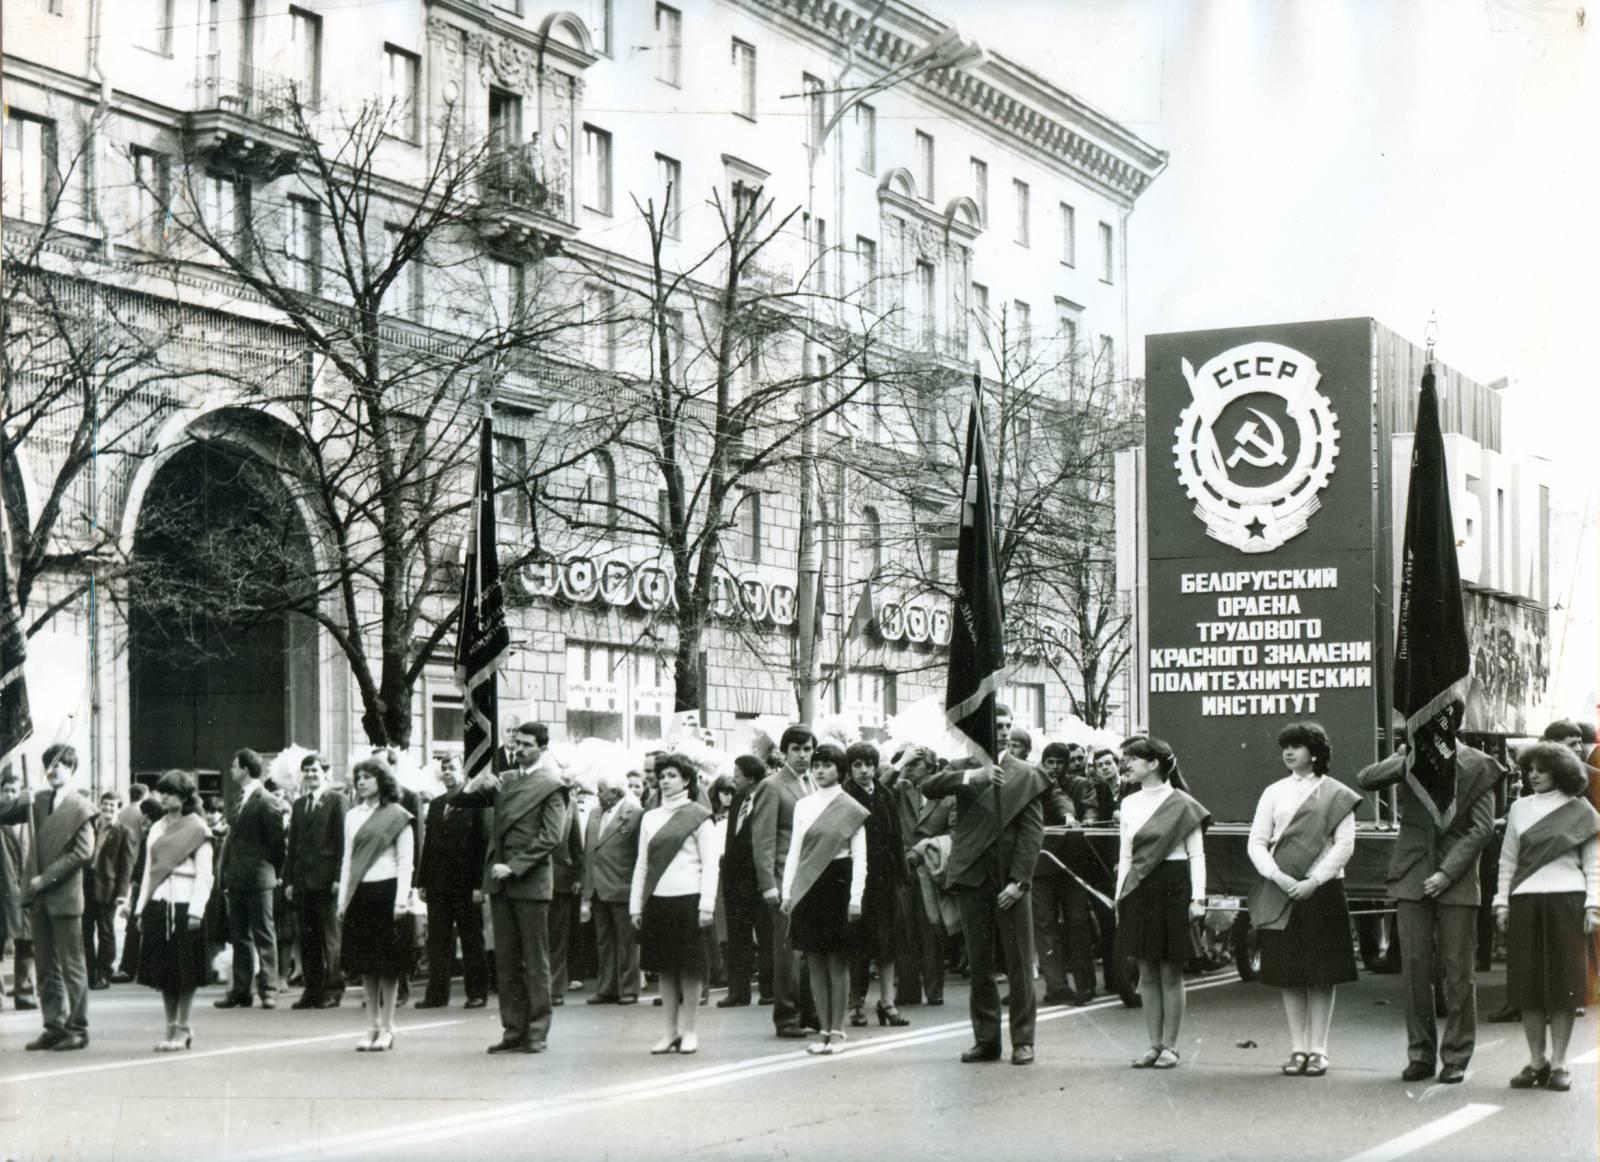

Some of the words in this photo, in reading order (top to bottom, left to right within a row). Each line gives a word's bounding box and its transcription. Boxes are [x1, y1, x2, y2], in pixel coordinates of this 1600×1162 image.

[1213, 356, 1298, 389] СССР
[1181, 567, 1338, 593] БЕЛОРУССКИЙ
[1217, 594, 1301, 617] ОРДЕНА
[1197, 618, 1322, 642] ТРУДОВОГО
[1151, 645, 1258, 668] КРАСНОГО
[1264, 641, 1371, 665] ЗНАМЕНИ
[1150, 666, 1372, 692] ПОЛИТЕХНИЧЕСКИЙ
[1202, 693, 1320, 716] ИНСТИТУТ
